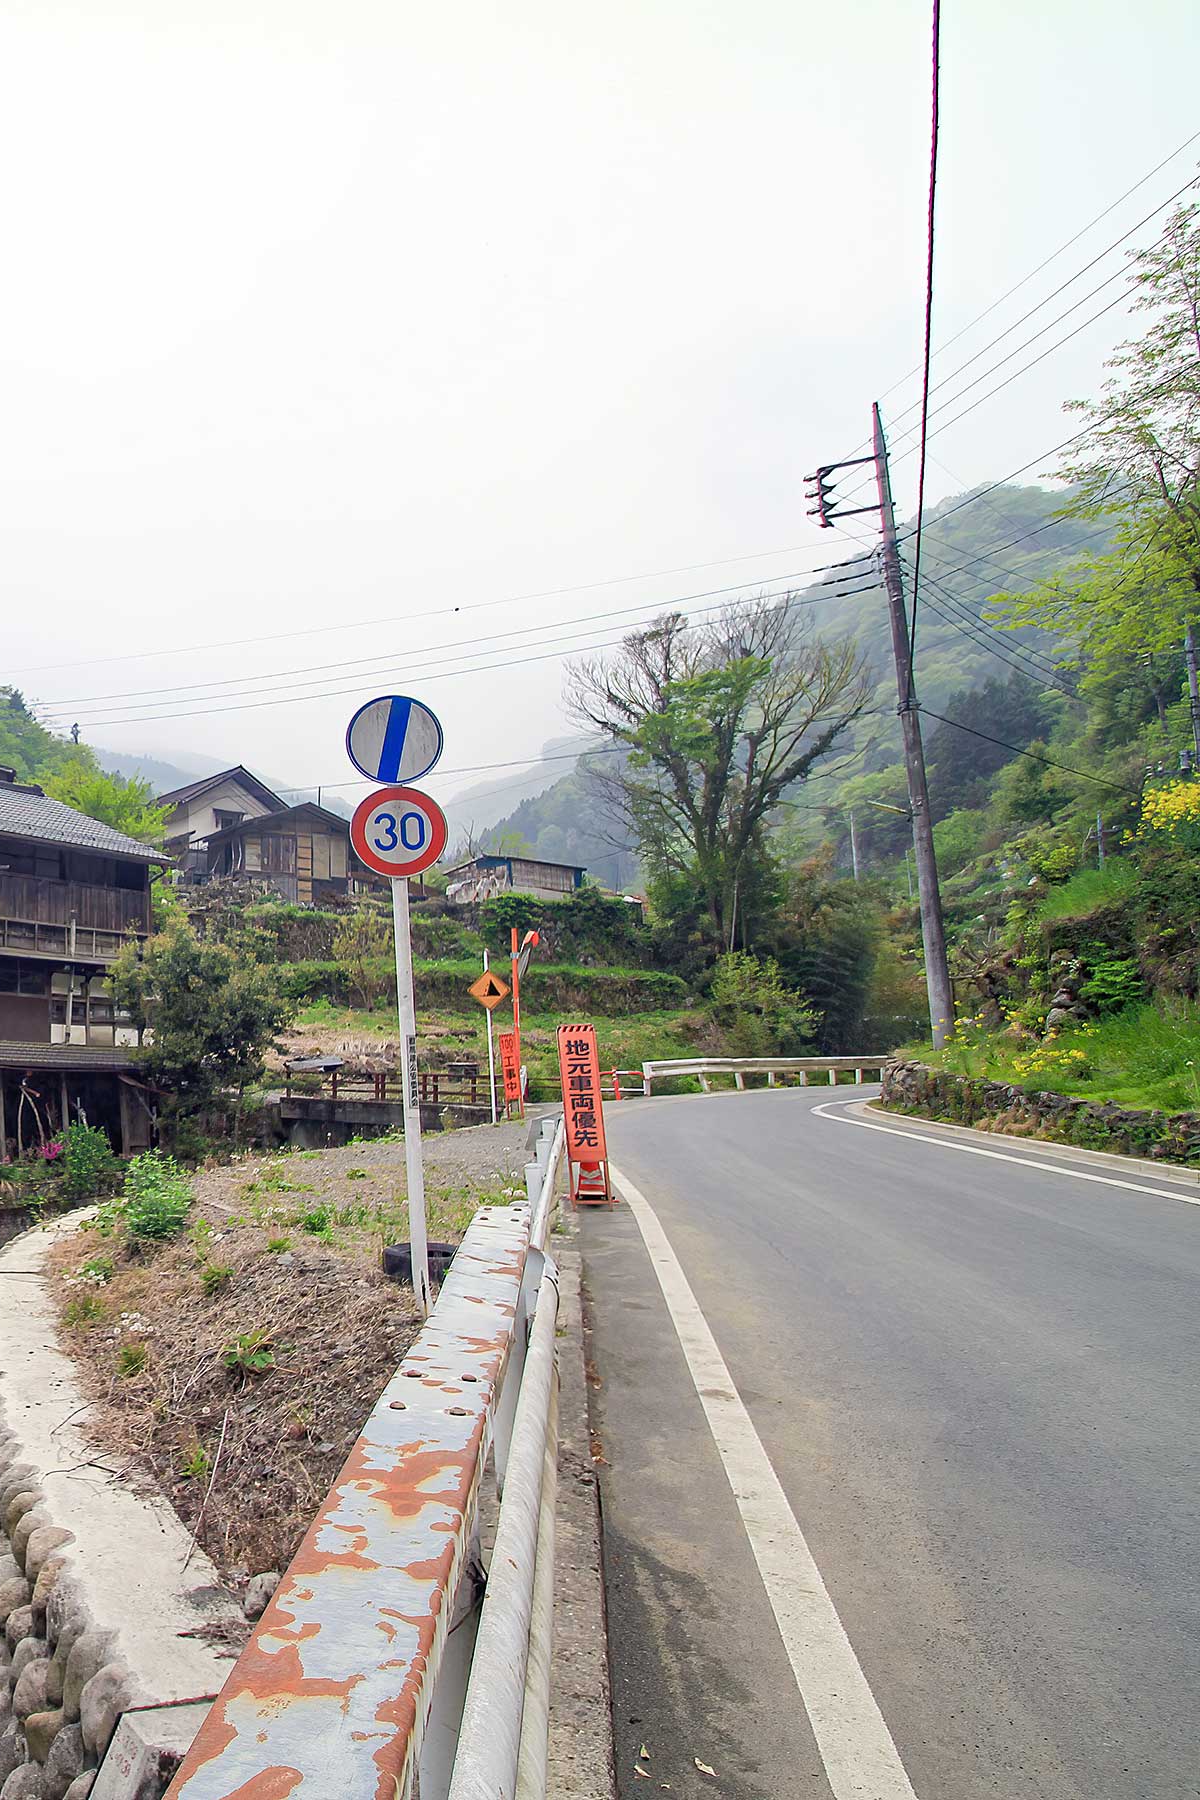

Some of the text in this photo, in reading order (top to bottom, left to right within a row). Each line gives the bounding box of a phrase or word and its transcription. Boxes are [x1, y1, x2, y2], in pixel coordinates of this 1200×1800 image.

[374, 812, 425, 852] 30
[504, 1055, 517, 1092] 工事中
[565, 1040, 598, 1148] 地元車両優先
